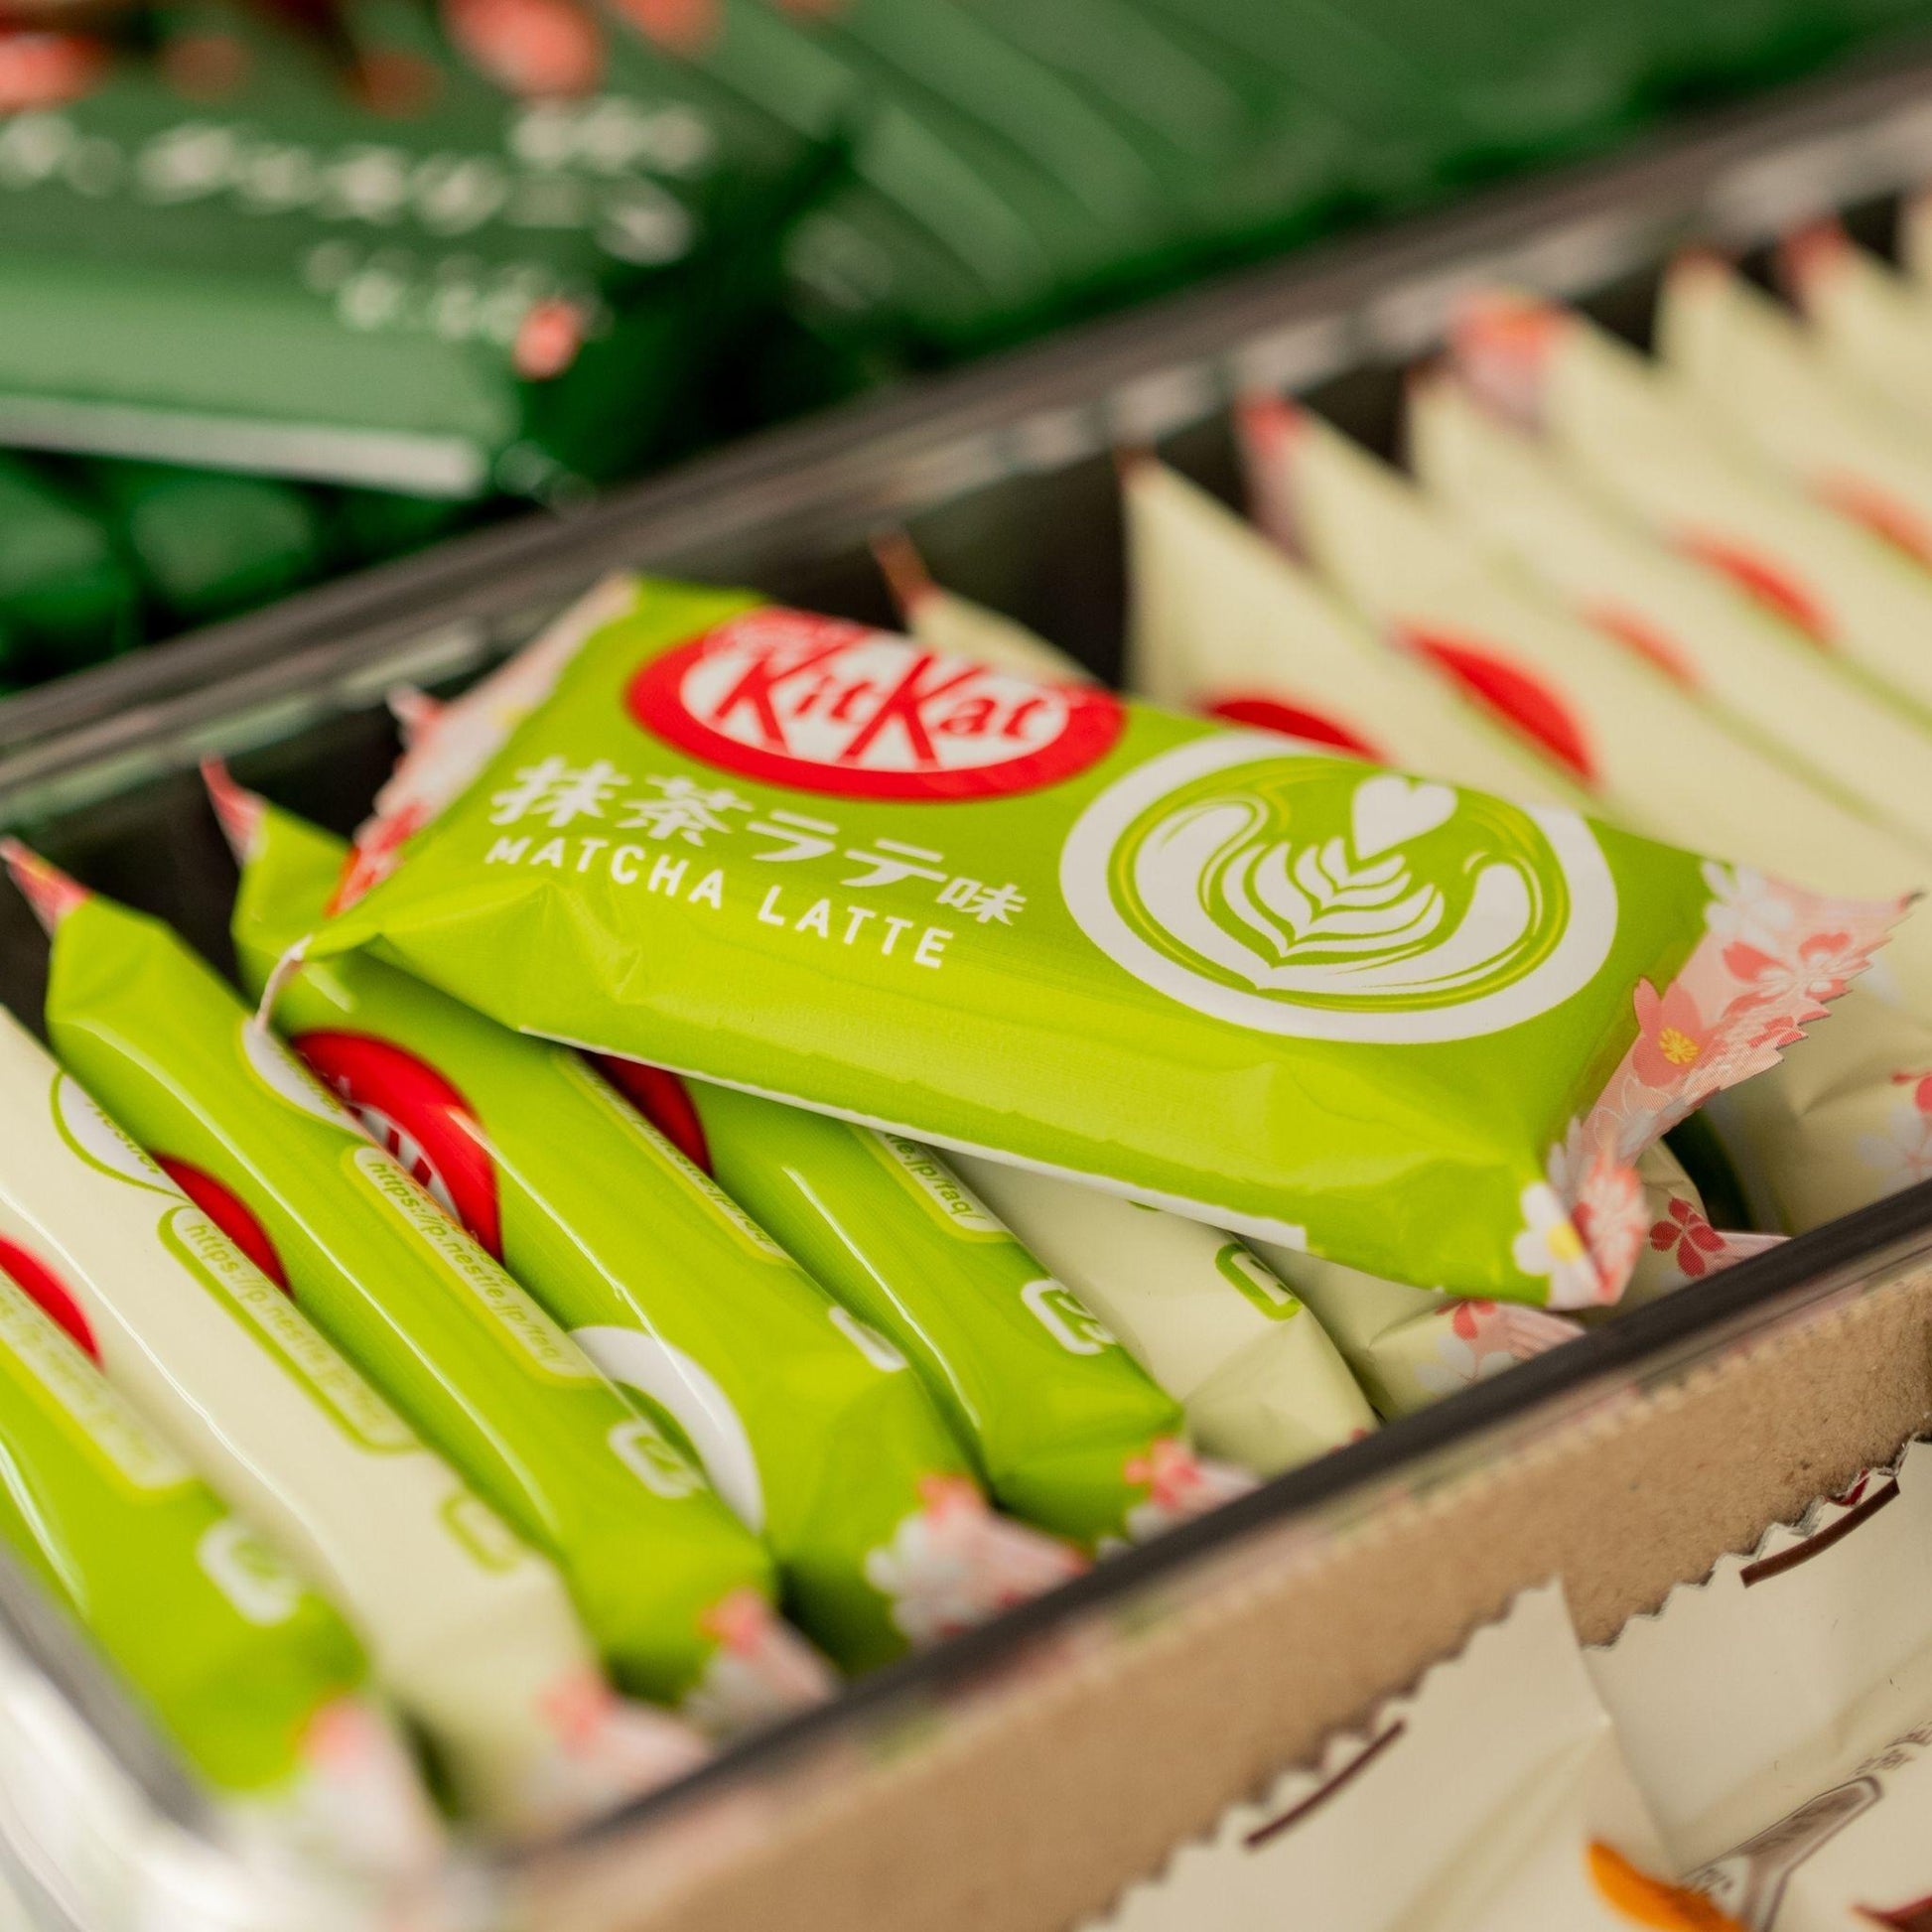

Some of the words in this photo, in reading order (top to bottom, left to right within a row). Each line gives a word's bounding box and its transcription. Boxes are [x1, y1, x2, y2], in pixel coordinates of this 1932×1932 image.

[714, 642, 1046, 768] KitKat
[484, 836, 725, 910] MATCHA
[758, 886, 955, 971] LATTE
[489, 757, 1028, 928] 抹茶ラテ味
